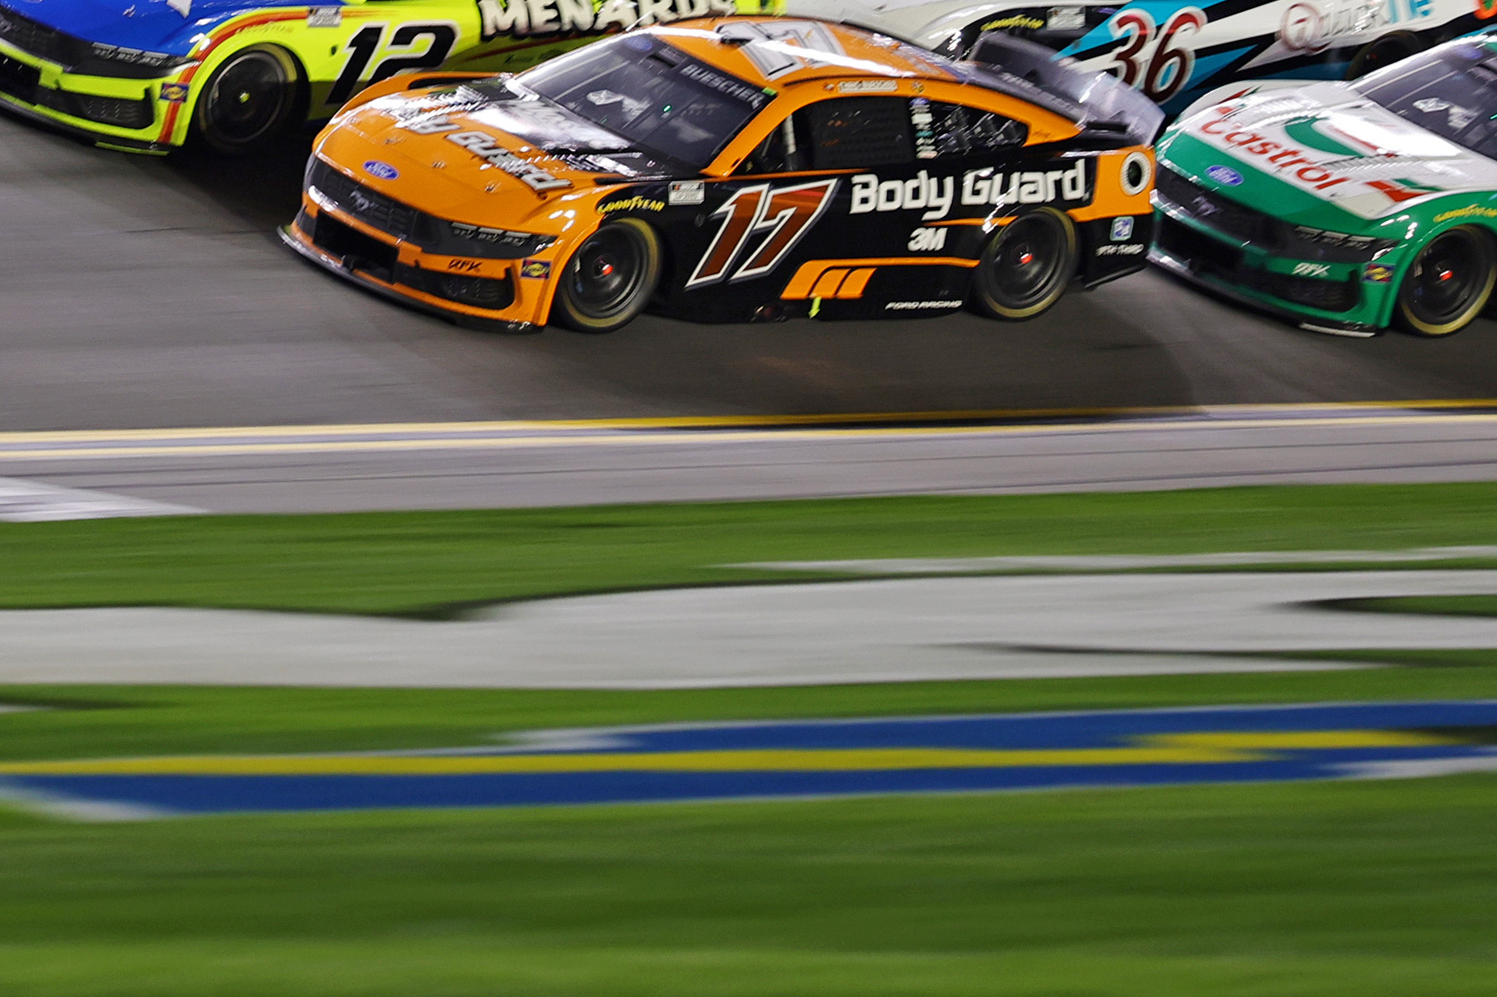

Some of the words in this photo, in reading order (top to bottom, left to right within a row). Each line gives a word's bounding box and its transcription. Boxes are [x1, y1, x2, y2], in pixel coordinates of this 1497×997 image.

[324, 19, 461, 105] 12
[680, 63, 767, 112] BUESCHER
[1108, 5, 1208, 106] 36
[1201, 118, 1352, 191] Castrol
[597, 195, 666, 215] GOODYEAR
[849, 169, 954, 222] Body
[960, 158, 1087, 205] Guard
[684, 177, 842, 290] 17
[906, 226, 949, 252] 3M
